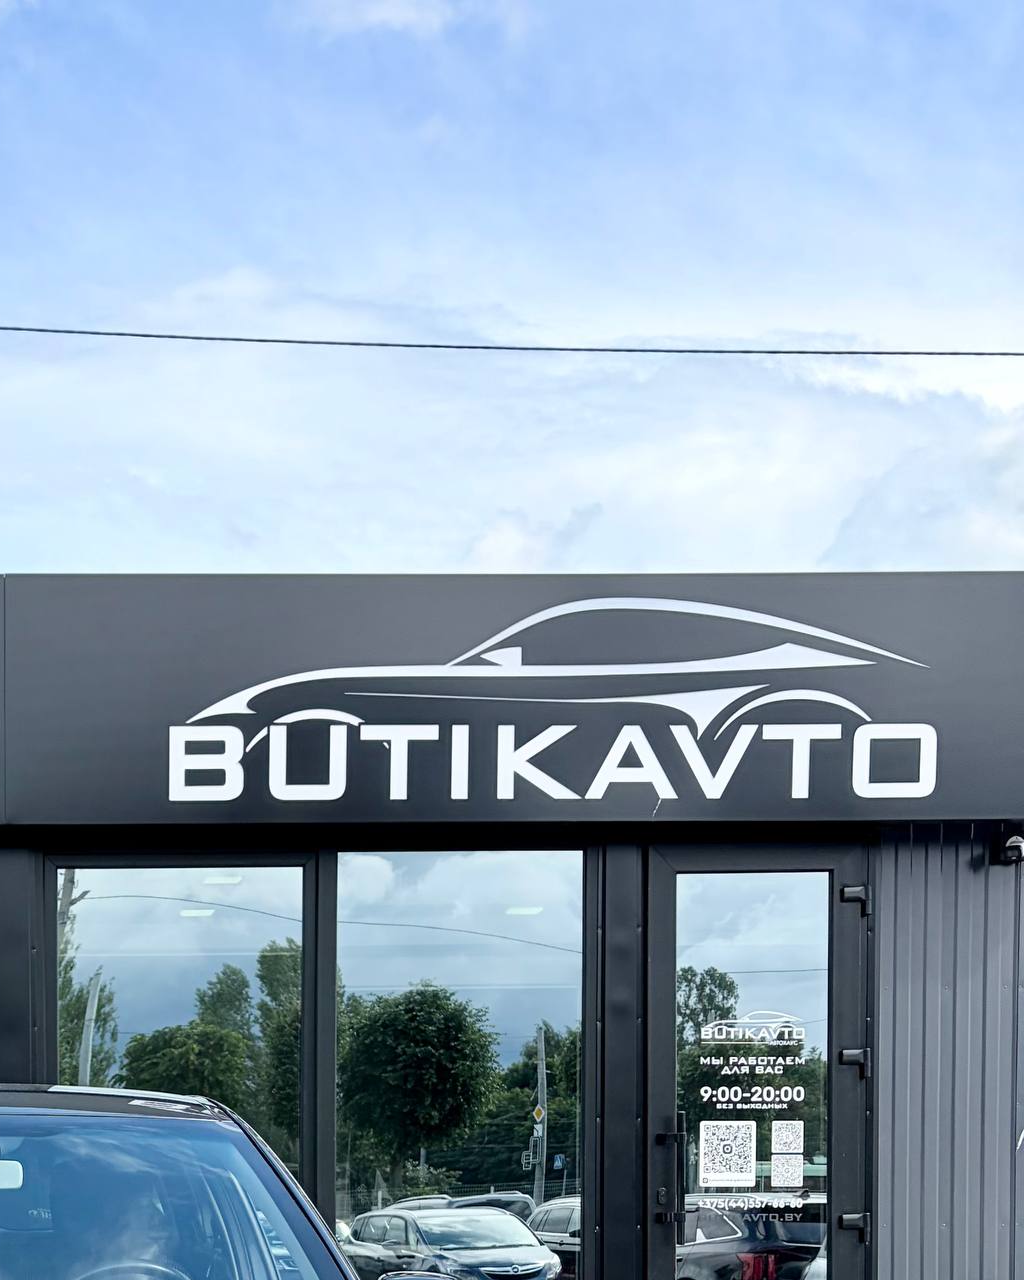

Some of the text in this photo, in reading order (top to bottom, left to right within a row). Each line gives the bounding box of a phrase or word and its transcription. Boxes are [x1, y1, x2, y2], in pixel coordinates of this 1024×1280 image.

[168, 722, 938, 802] BUTIKAVTO
[700, 1027, 806, 1040] BUTIKAVTO
[700, 1056, 806, 1065] МЫ РАБОТАЕМ
[721, 1066, 784, 1075] ДЛЯ ВАС
[699, 1086, 805, 1102] 9:00-20:00
